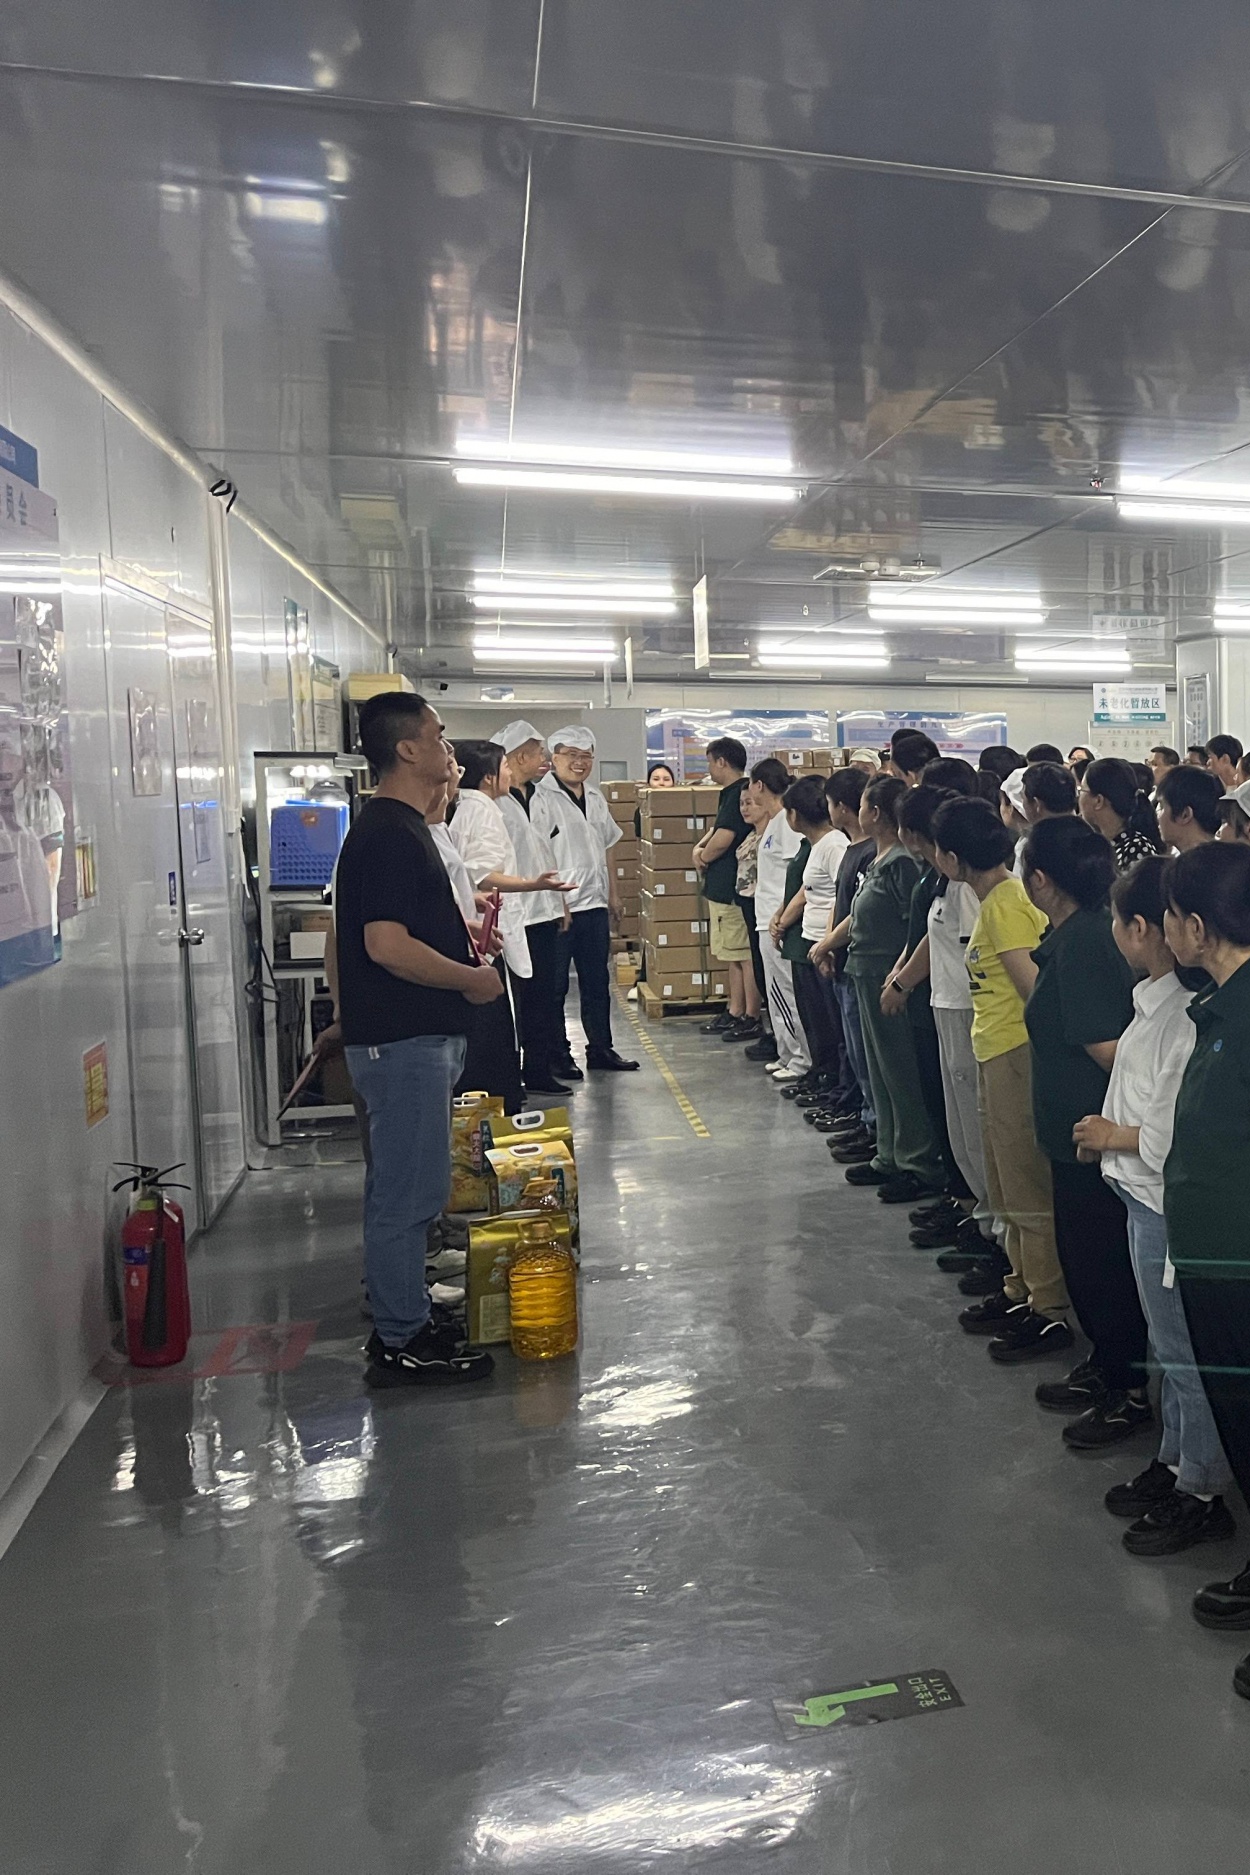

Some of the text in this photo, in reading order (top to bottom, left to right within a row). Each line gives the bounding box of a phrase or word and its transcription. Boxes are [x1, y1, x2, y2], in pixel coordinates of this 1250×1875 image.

[0, 484, 27, 526] 员会
[1099, 697, 1161, 710] 未老化暂放区
[907, 1676, 939, 1708] 安全出口
[928, 1677, 952, 1702] EXIT
